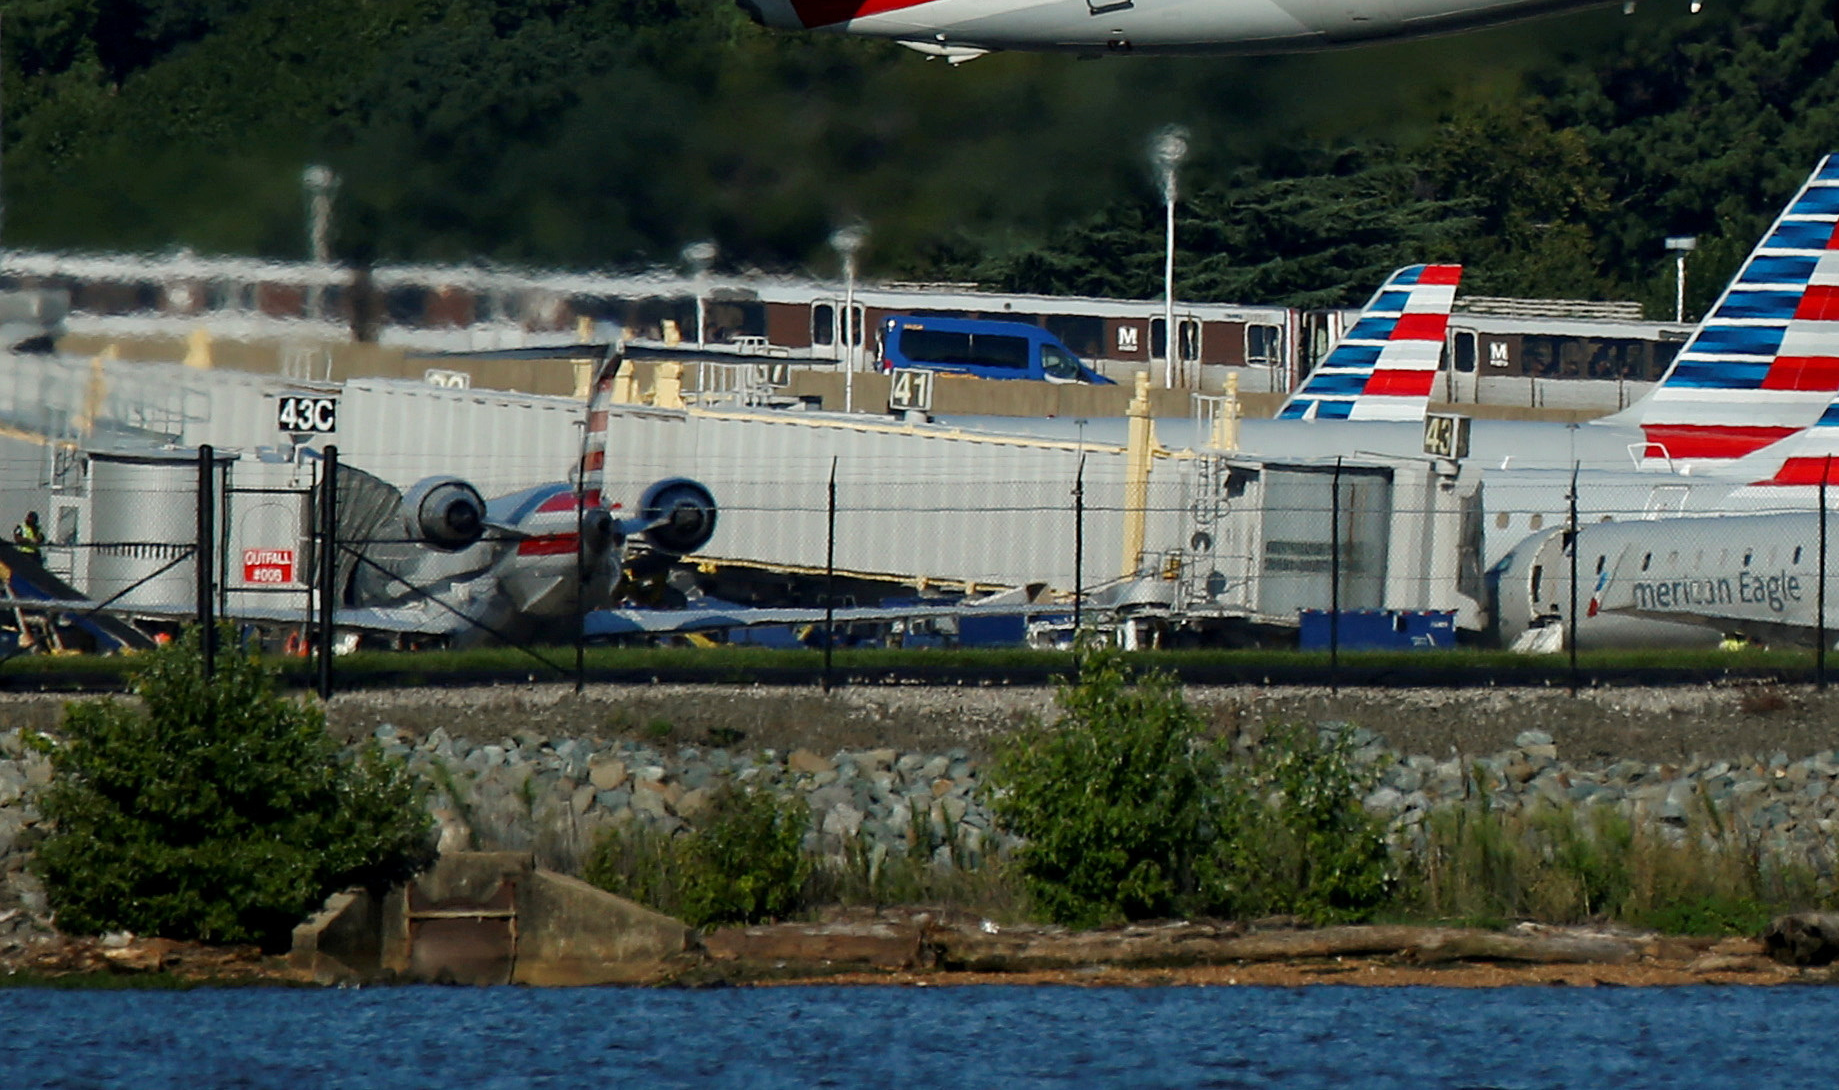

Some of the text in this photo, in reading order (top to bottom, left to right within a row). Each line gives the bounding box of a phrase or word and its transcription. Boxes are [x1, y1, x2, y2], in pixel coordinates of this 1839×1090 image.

[1118, 326, 1138, 345] M
[1490, 341, 1509, 360] M
[894, 372, 927, 407] 41
[280, 398, 334, 431] 43C
[1425, 417, 1452, 455] 43
[245, 551, 291, 565] OUTFALL
[1633, 569, 1801, 612] merican Eagle
